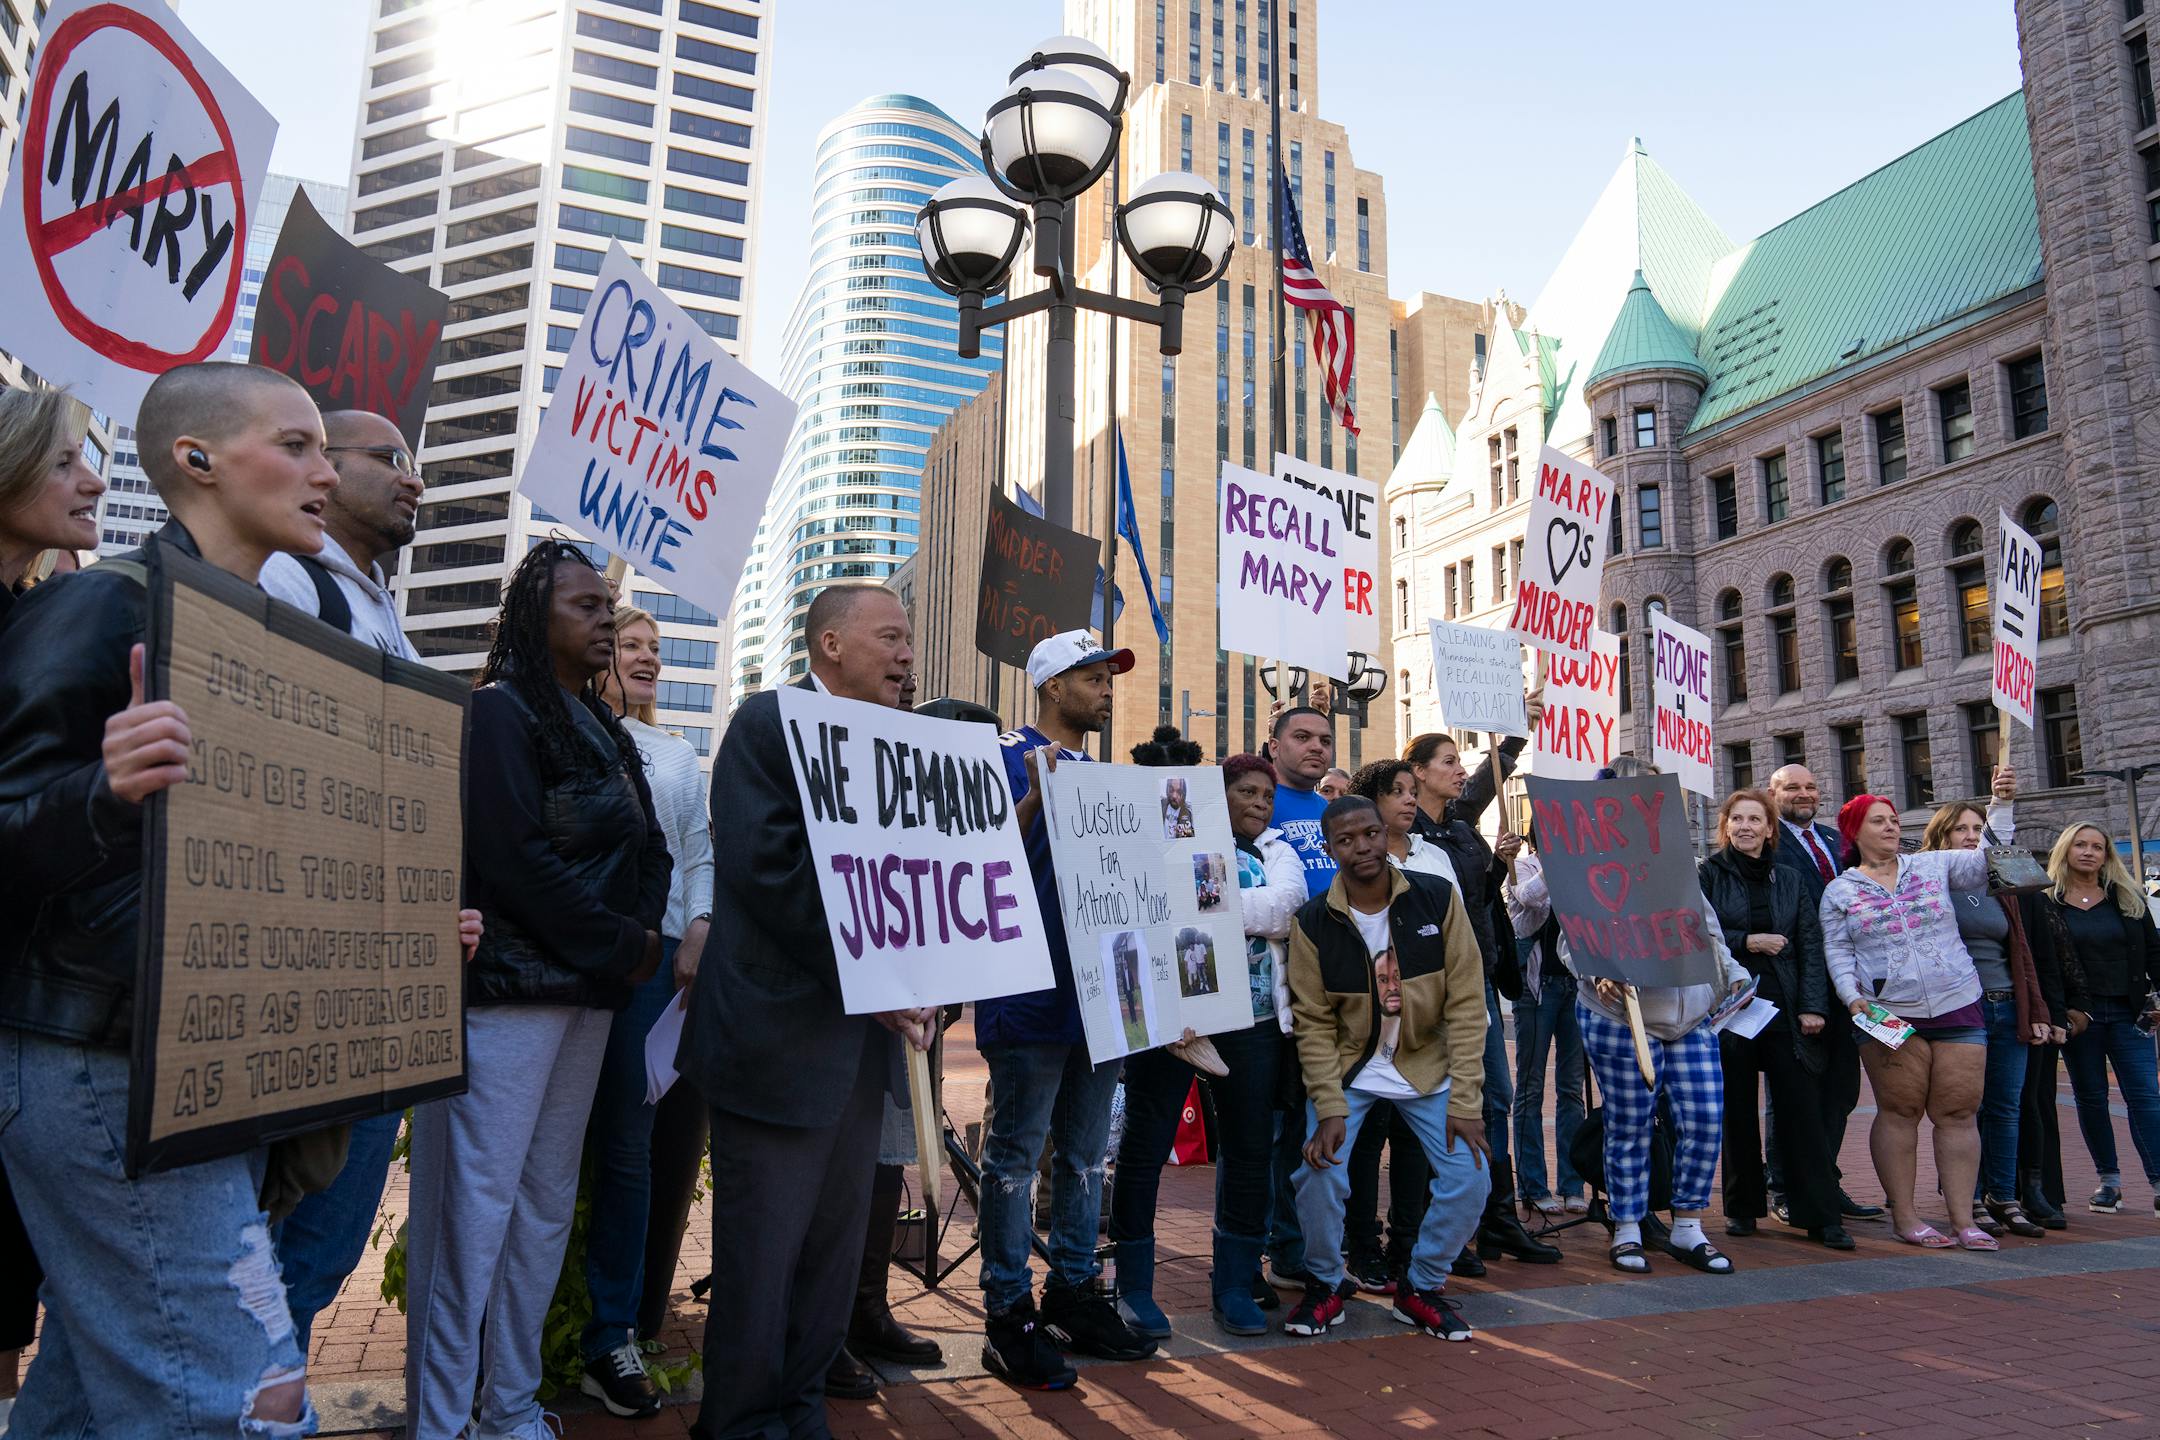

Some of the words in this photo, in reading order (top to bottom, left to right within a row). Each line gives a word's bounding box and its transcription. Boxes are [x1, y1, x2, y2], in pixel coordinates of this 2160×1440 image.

[47, 70, 235, 303] MARY
[259, 255, 440, 425] SCARY
[1226, 482, 1336, 557] RECALL
[1539, 463, 1607, 524] MARY
[989, 506, 1064, 585] MURDER
[1240, 550, 1332, 615] MARY
[980, 583, 1057, 647] PRISO
[1435, 625, 1496, 650] CLEANING
[1502, 638, 1518, 652] UP
[1510, 579, 1594, 653] MURDER
[1446, 667, 1511, 688] RECALLING
[1656, 629, 1709, 703] ATONE
[1994, 636, 2034, 717] URDER
[207, 652, 339, 736] JUSTICE
[365, 715, 434, 768] WILL
[1538, 704, 1614, 767] MARY
[1657, 705, 1713, 768] MURDER
[1676, 694, 1686, 718] 4
[321, 777, 426, 834] SERVED
[789, 718, 858, 824] WE
[873, 737, 1008, 837] DEMAND
[1072, 786, 1141, 838] Justice
[1534, 791, 1665, 855] MARY
[185, 837, 284, 893] UNTIL
[301, 856, 384, 903] THOSE
[397, 866, 455, 903] WHO
[831, 853, 1023, 960] JUSTICE
[1075, 873, 1130, 935] Antonio
[1559, 907, 1707, 961] MURDER
[183, 923, 249, 969] ARE
[261, 926, 437, 970] UNAFFECTED
[178, 994, 246, 1043] ARE
[260, 990, 300, 1035] AS
[314, 984, 447, 1030] OUTRAGED
[174, 1061, 223, 1117] AS
[246, 1042, 338, 1099] THOSE
[348, 1036, 403, 1080] WHO
[407, 1028, 459, 1067] ARE.
